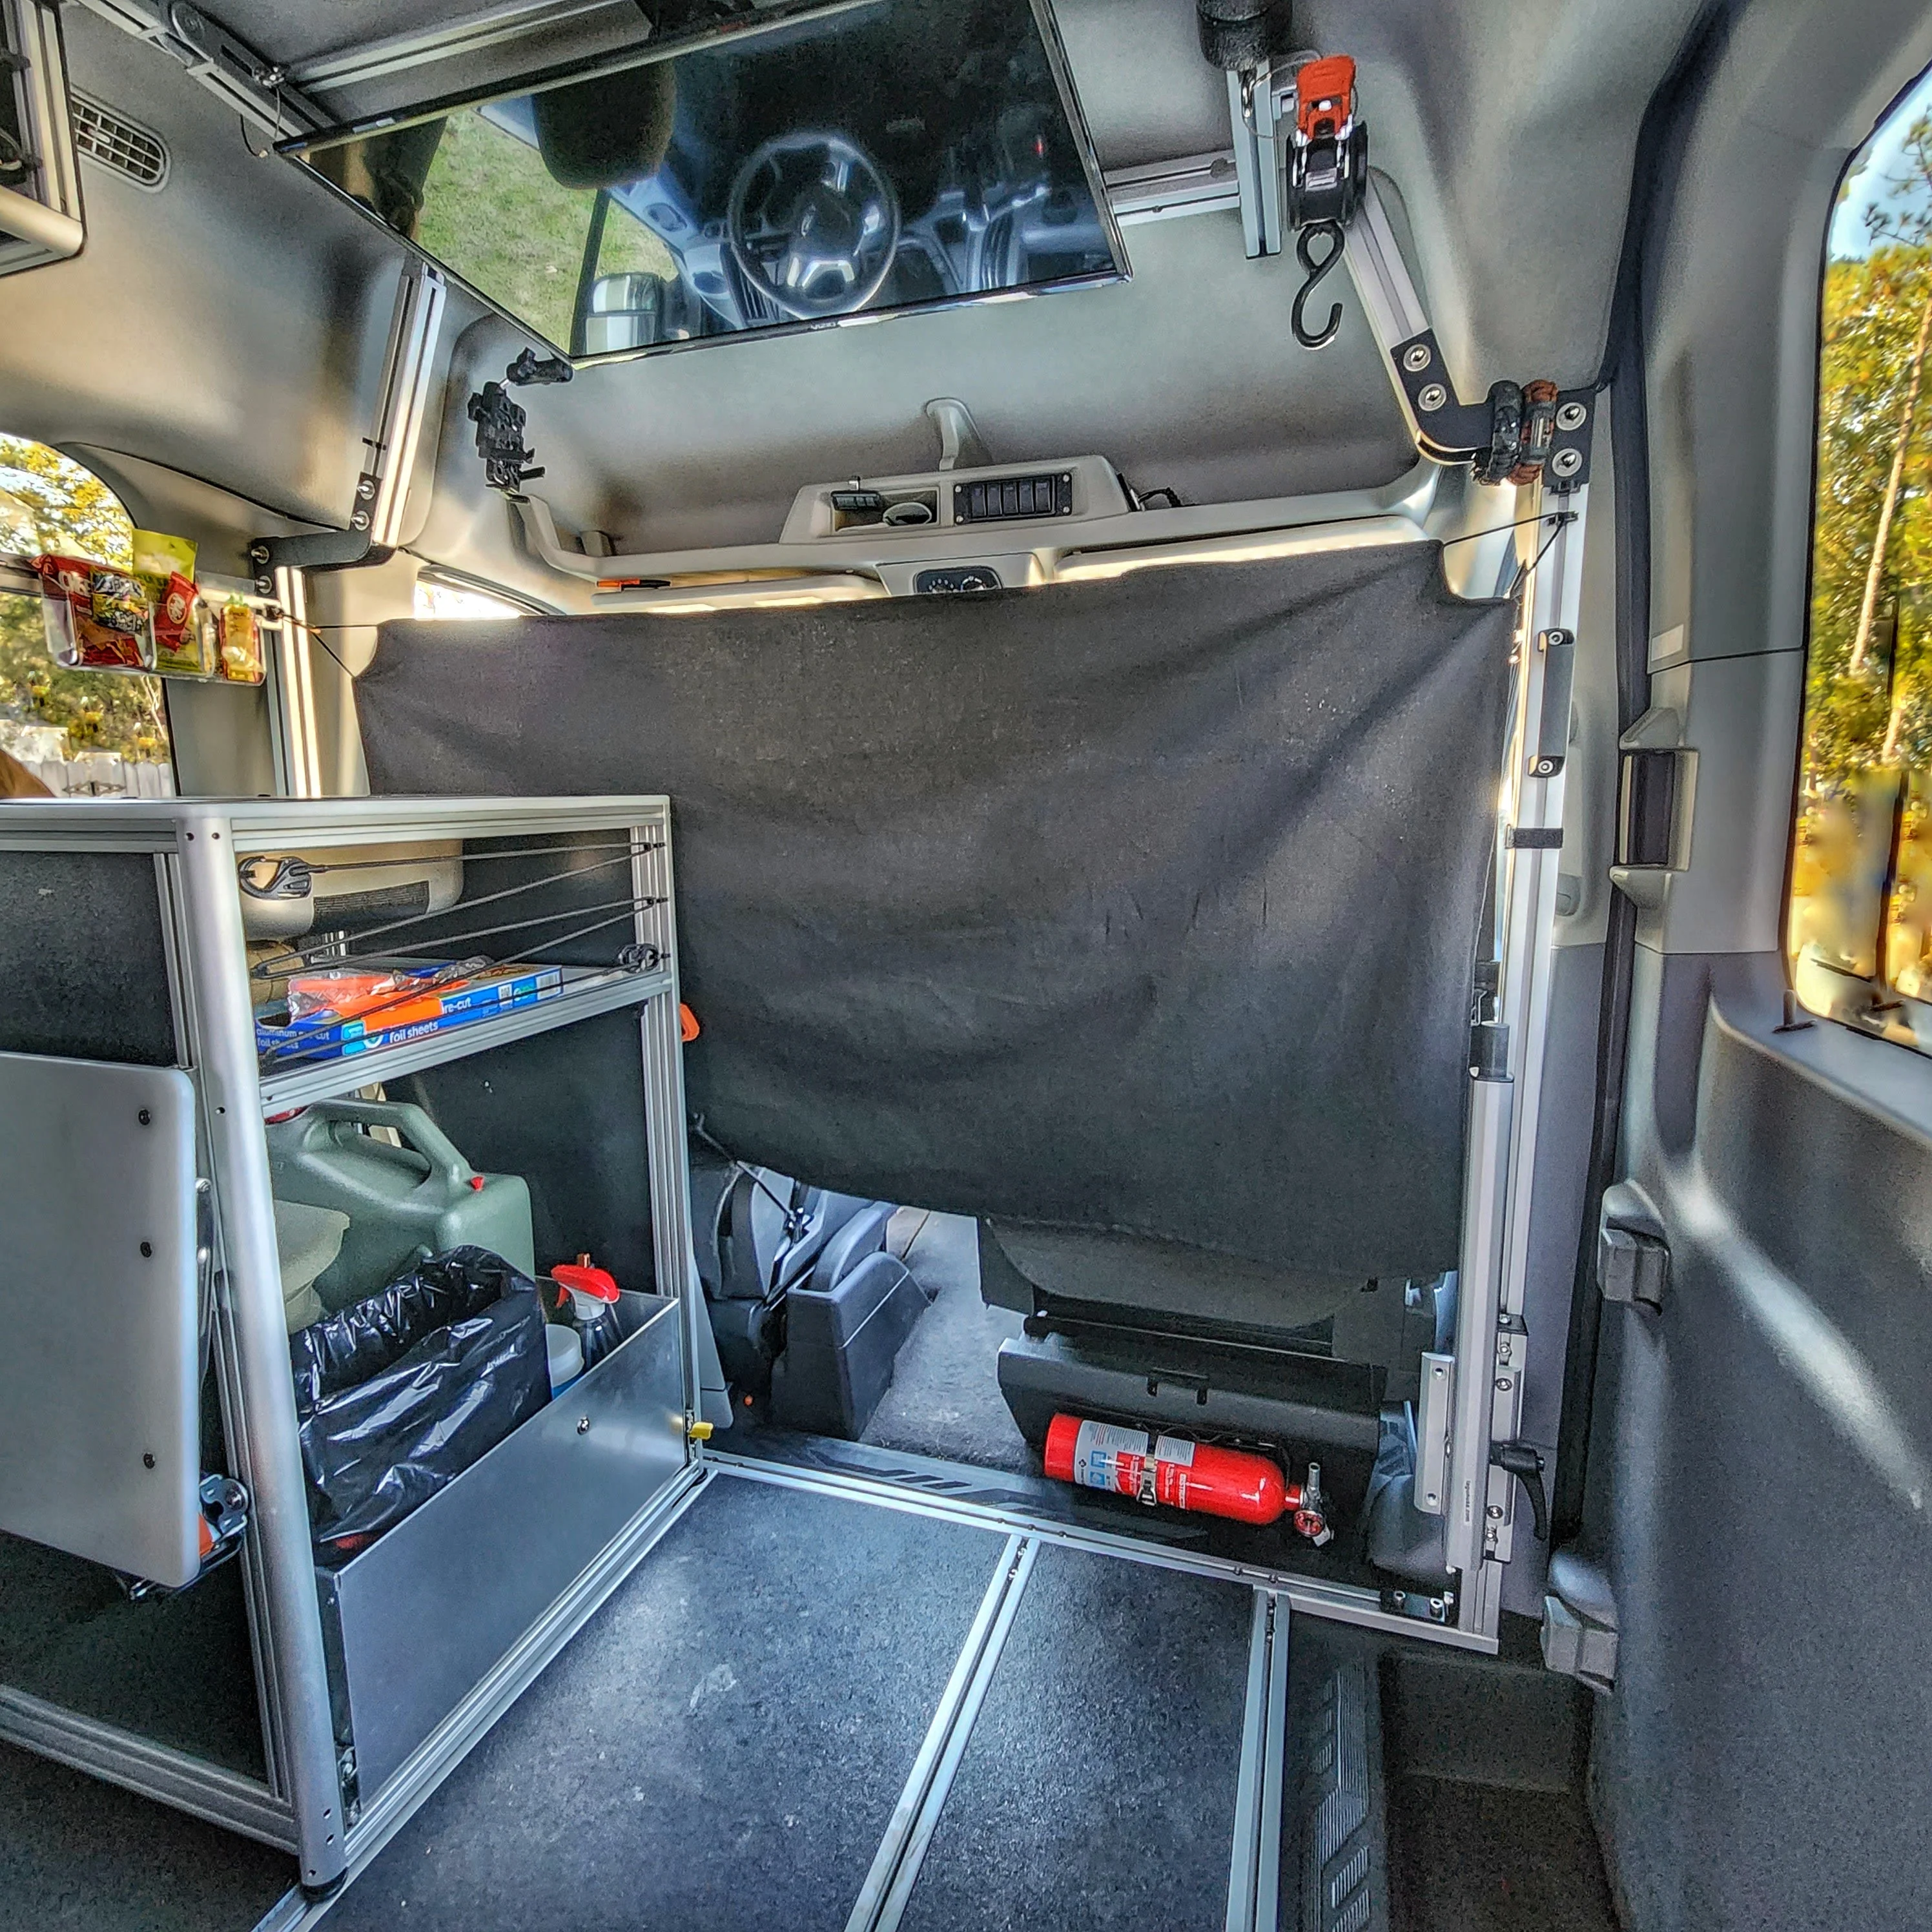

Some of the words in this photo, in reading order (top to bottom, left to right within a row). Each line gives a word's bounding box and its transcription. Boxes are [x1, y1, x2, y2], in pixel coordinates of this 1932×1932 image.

[256, 1028, 297, 1037] aluminum
[389, 1029, 406, 1043] foil
[407, 1021, 438, 1038] sheets
[271, 1039, 299, 1049] shts
